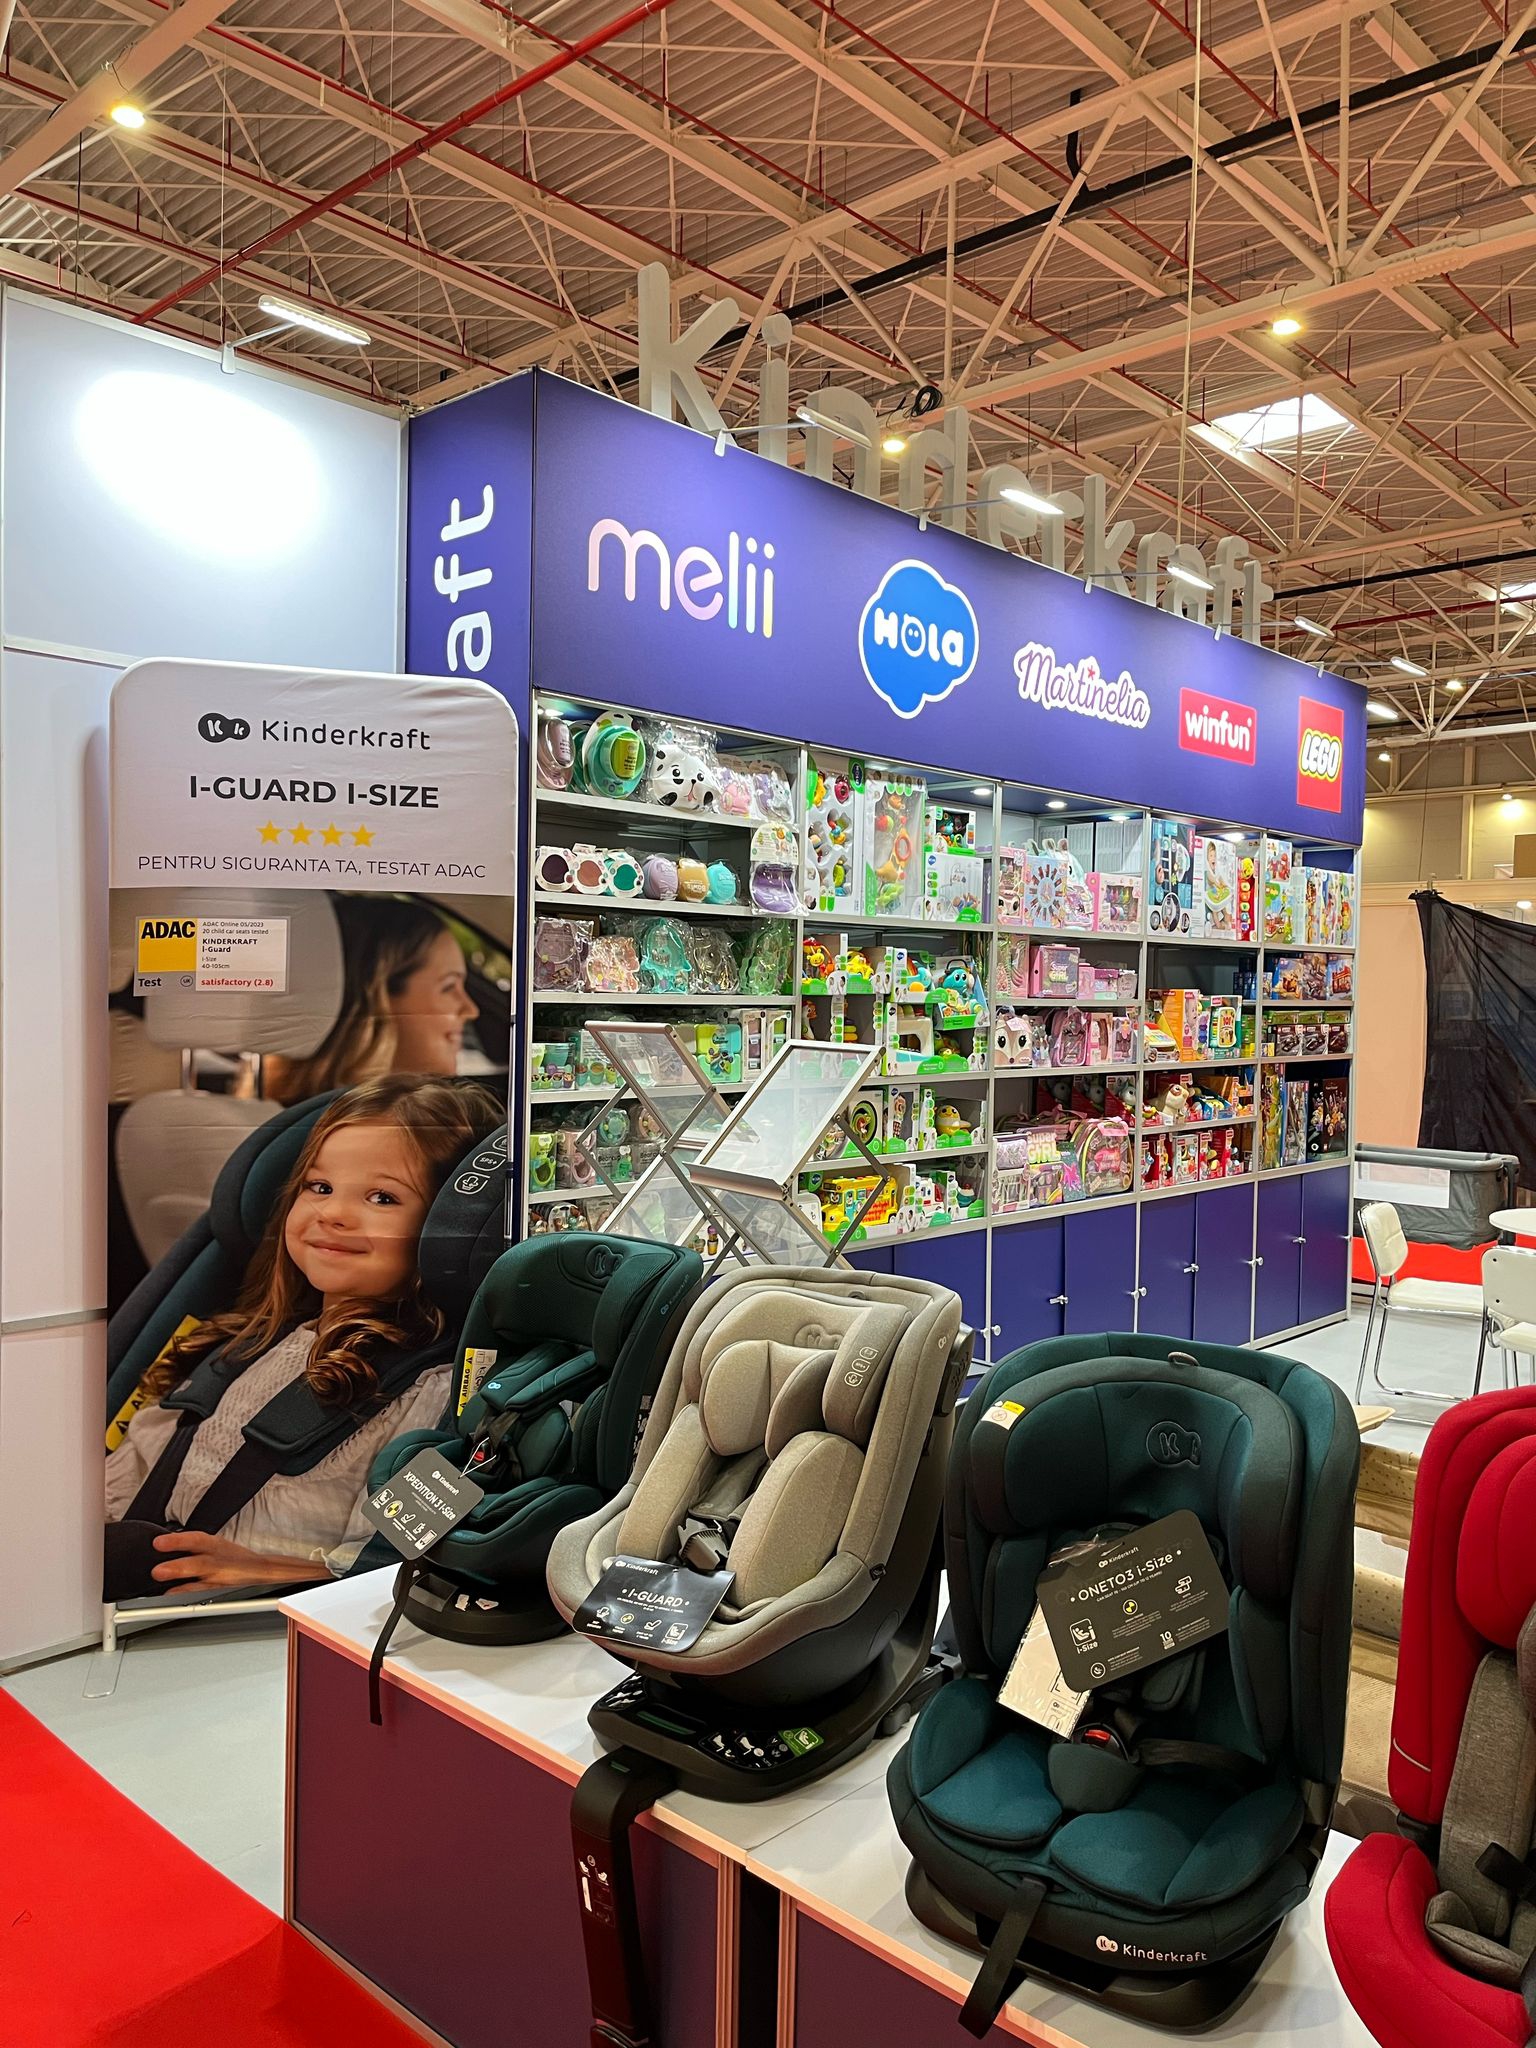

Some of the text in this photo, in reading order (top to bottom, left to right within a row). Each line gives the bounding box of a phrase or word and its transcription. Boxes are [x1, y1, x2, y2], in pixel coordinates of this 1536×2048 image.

[588, 518, 774, 638] melii
[1017, 649, 1148, 723] Martinelia
[261, 720, 431, 751] Kinderkraft
[1185, 704, 1252, 752] winfun
[1300, 730, 1342, 780] LEGO
[190, 775, 440, 809] I-GUARD I-SIZE
[138, 855, 487, 879] PENTRU SIGURANTA TA, TESTAT ADAC
[141, 920, 196, 940] ADAC
[202, 938, 258, 946] KINDERKRAFT
[138, 976, 162, 988] Test
[201, 977, 274, 988] satisfactory (2.8)
[462, 1368, 471, 1397] AIRBAG
[403, 1471, 438, 1506] XPEDITION
[434, 1499, 442, 1508] 3
[1078, 1553, 1174, 1601] ONETO3 i-Size
[628, 1589, 683, 1607] I-GUARD
[1159, 1631, 1172, 1643] 10
[1122, 1943, 1207, 1962] Kinderkraft
